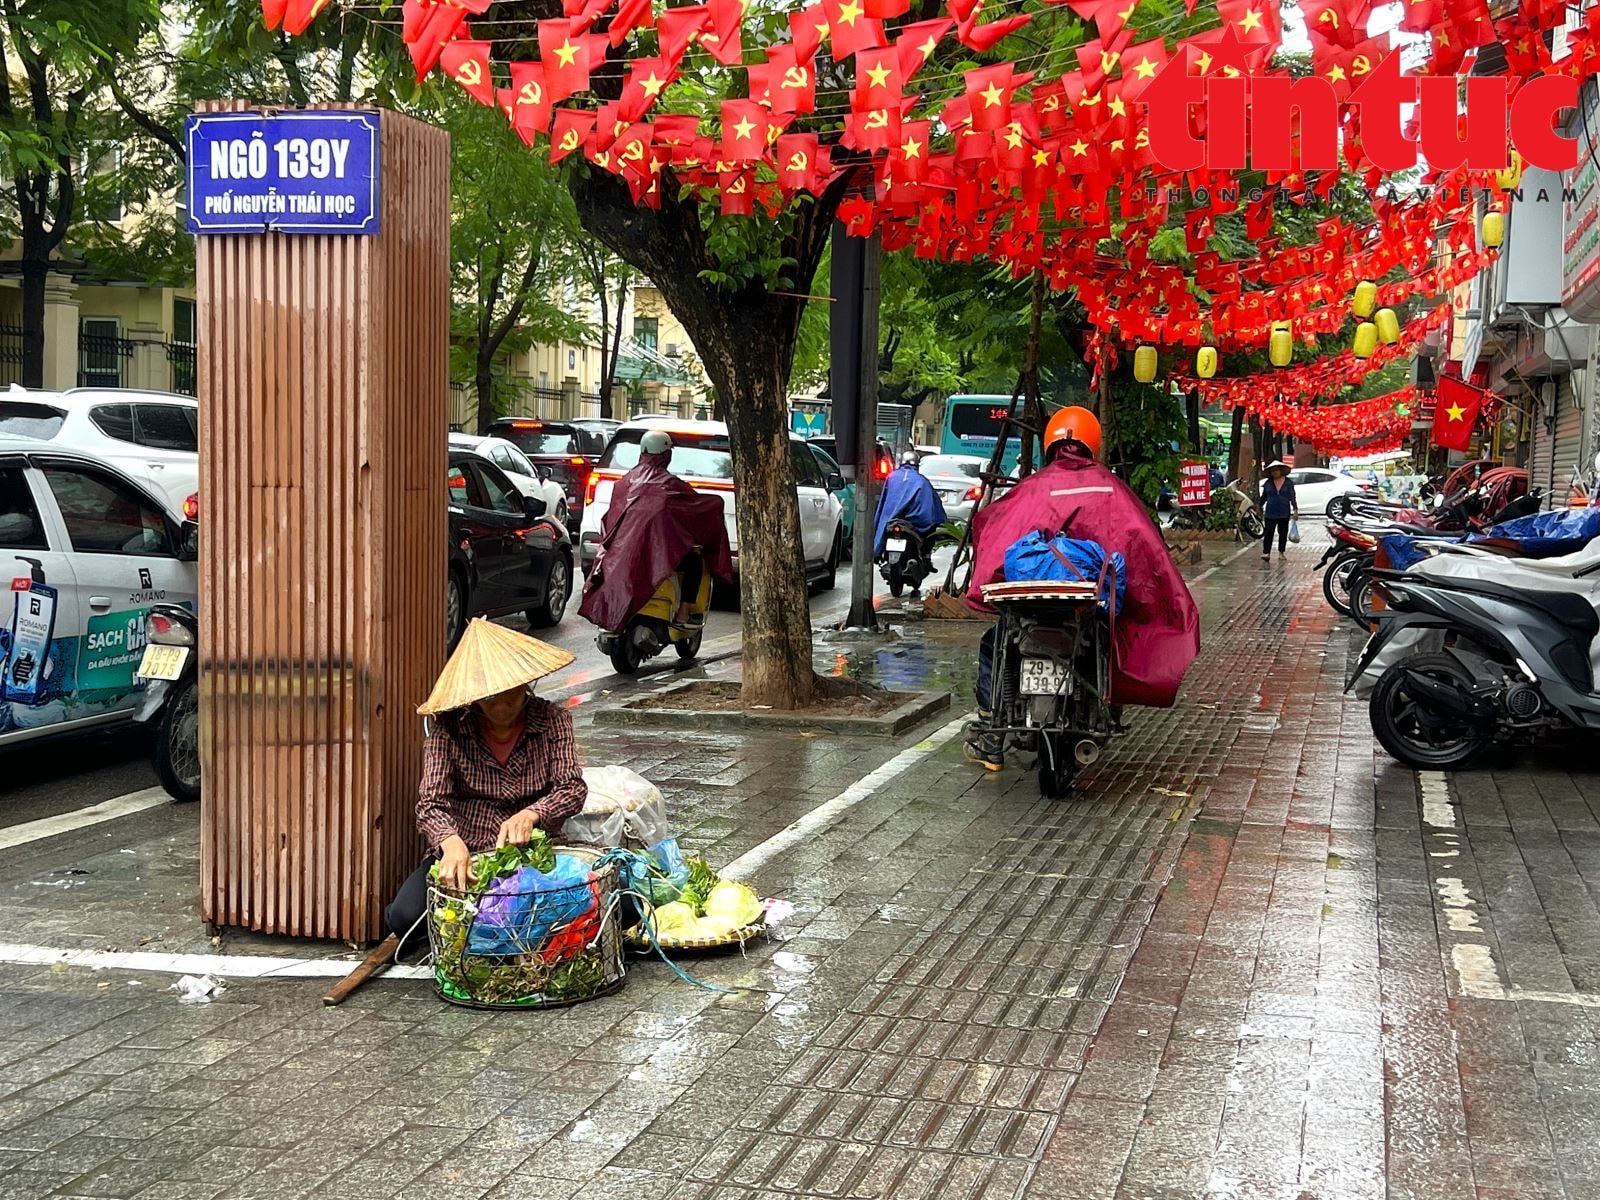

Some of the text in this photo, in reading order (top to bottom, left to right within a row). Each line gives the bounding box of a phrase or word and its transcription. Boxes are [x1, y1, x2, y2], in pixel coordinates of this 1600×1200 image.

[210, 130, 350, 179] NGÕ 139Y
[205, 187, 355, 219] PHỐ NGUYỄN THÁI HỌC
[129, 590, 166, 604] ROMANO
[19, 617, 48, 632] ROMANO
[87, 629, 123, 653] SẠCH
